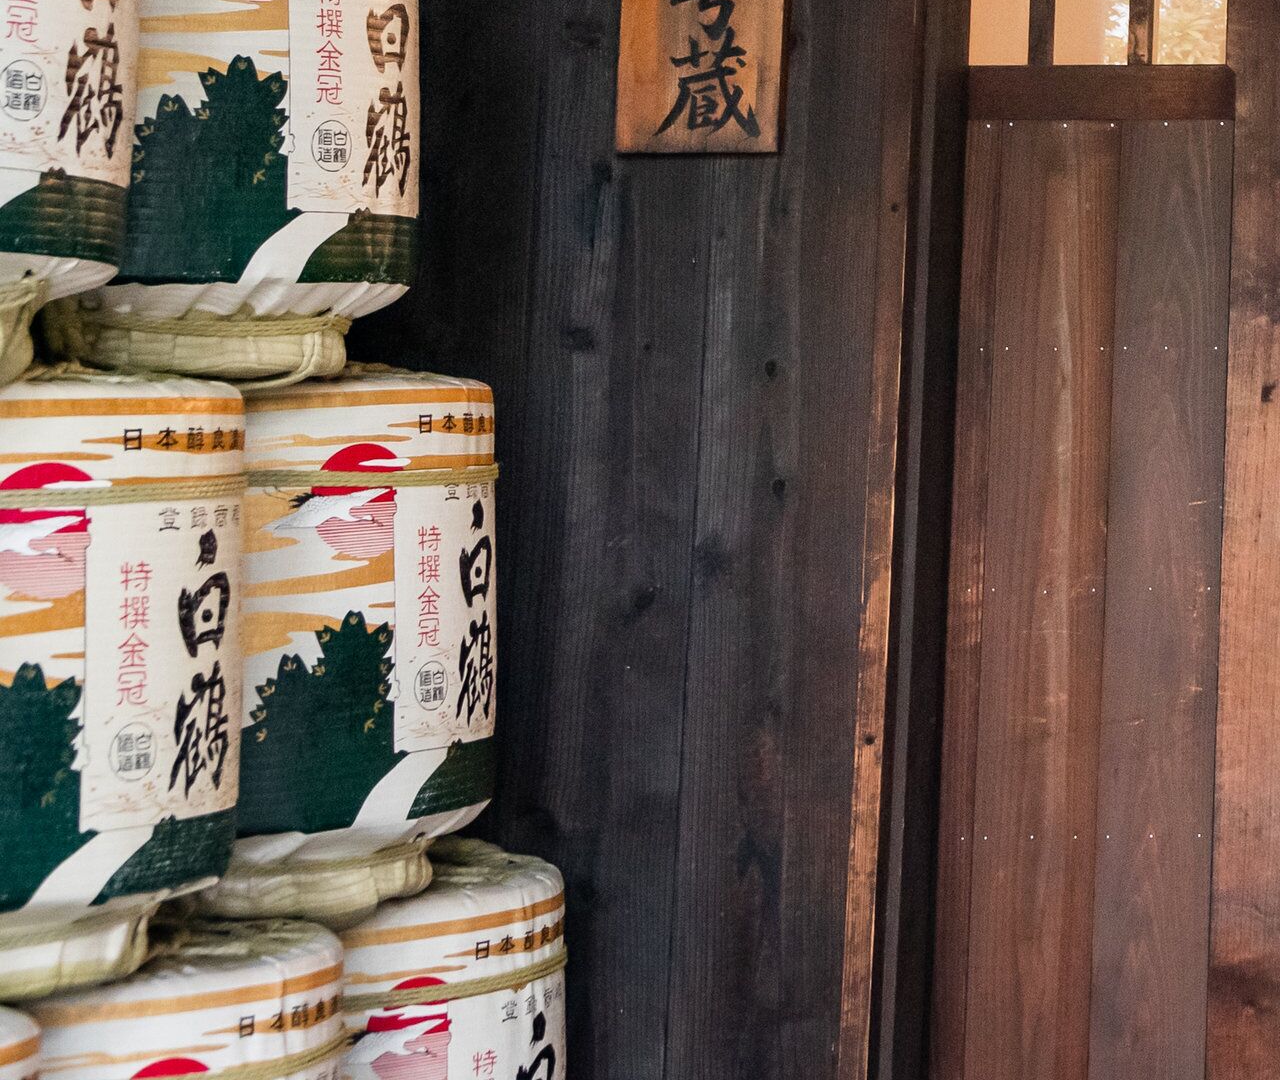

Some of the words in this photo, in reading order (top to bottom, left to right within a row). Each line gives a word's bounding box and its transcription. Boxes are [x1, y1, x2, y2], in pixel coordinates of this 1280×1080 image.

[116, 560, 152, 706] 特撰金冠
[417, 524, 442, 648] 特撰金冠
[472, 1049, 498, 1080] 特
